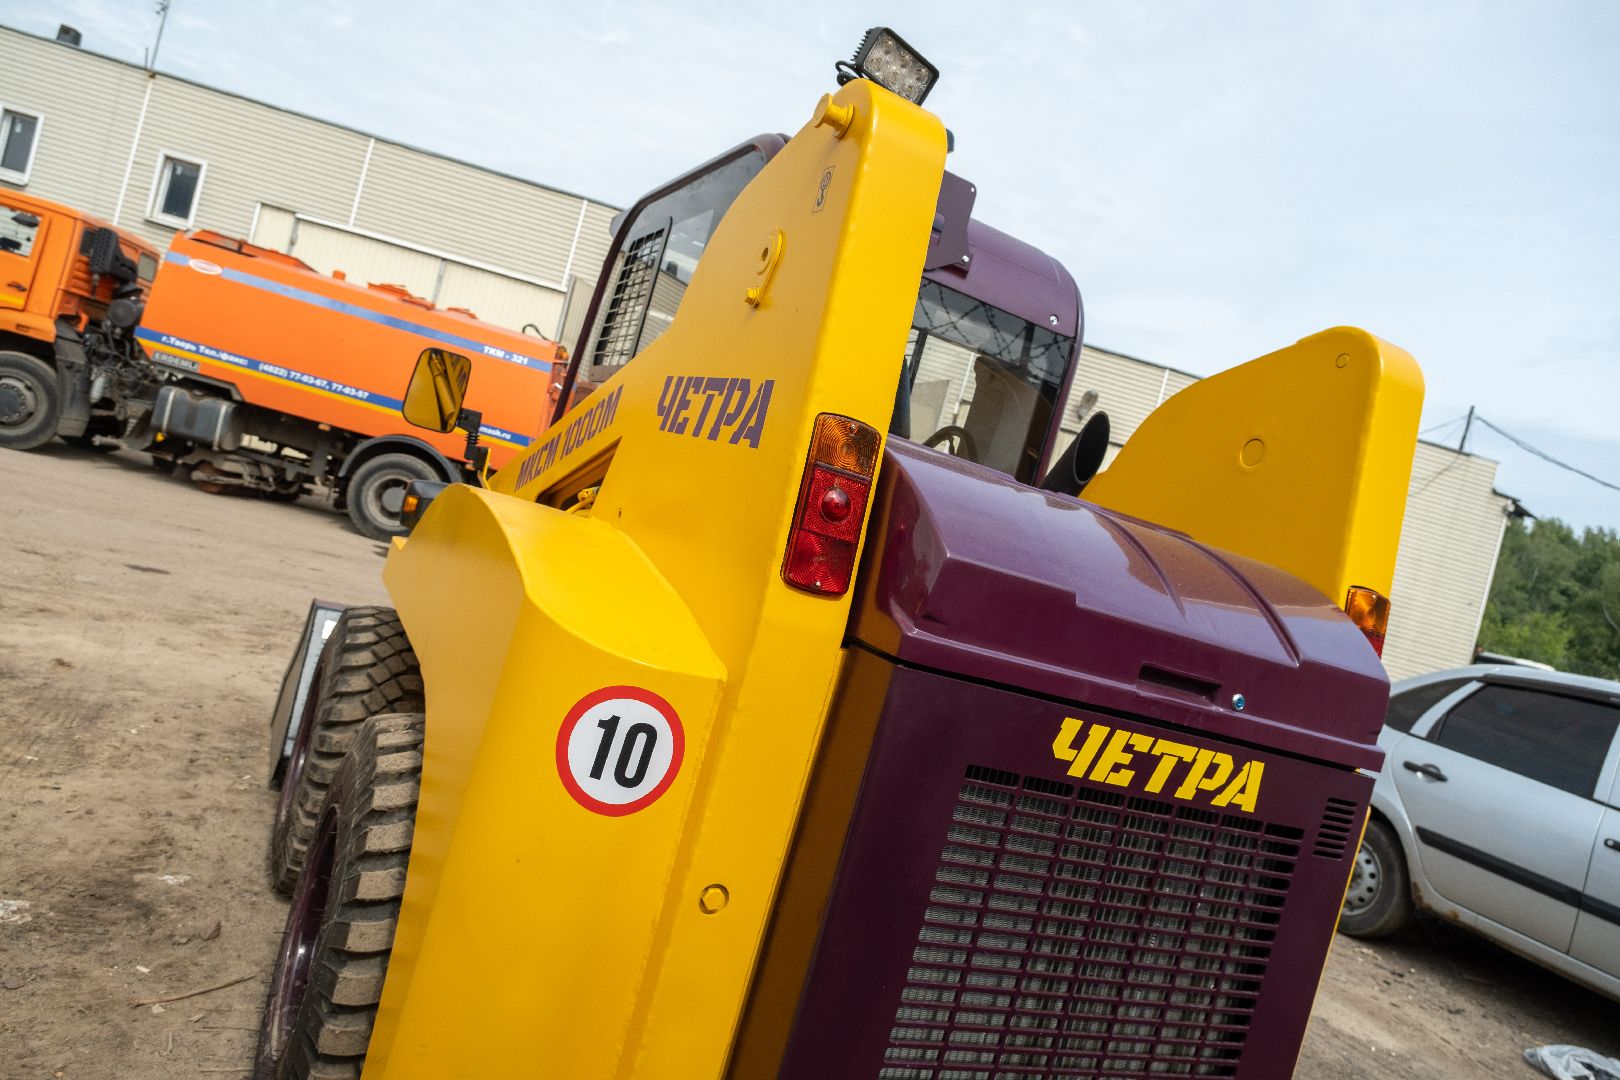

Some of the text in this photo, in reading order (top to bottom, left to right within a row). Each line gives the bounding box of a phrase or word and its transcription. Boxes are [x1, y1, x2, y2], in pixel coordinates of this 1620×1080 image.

[510, 353, 529, 366] 321
[514, 383, 624, 493] МКСМ 1000М
[656, 375, 775, 450] ЧЕТРА
[588, 714, 658, 789] 10
[1052, 716, 1265, 813] ЧЕТРА
